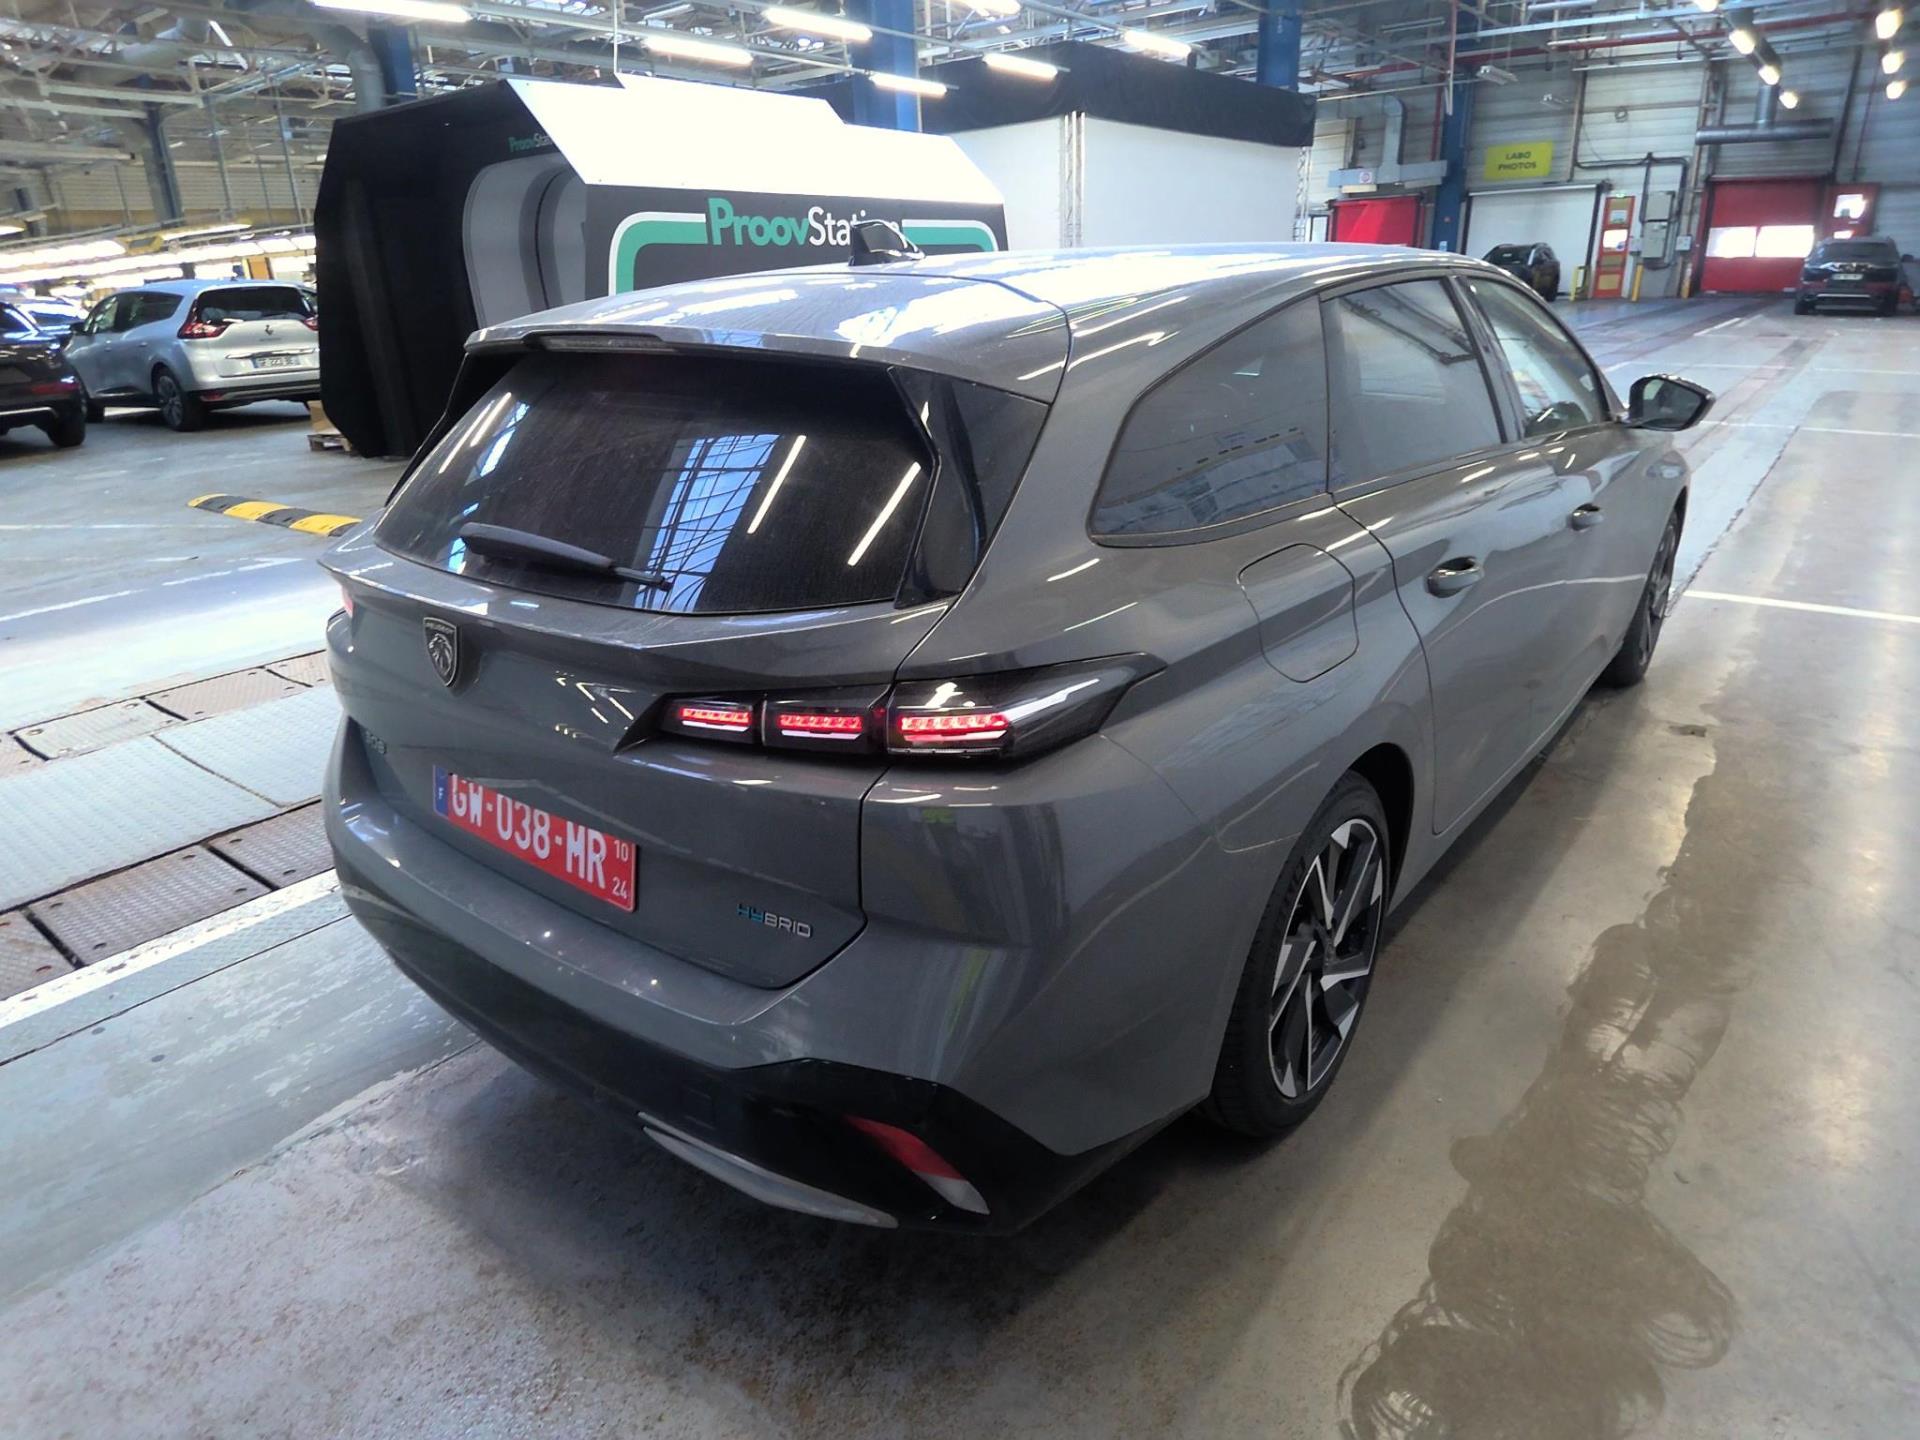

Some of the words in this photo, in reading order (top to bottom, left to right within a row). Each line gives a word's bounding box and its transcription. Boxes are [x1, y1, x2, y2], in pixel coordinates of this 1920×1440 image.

[1498, 161, 1537, 171] PHOTOS
[1505, 151, 1532, 160] LABO
[452, 773, 607, 889] GW-038-MR
[613, 839, 629, 862] 10
[612, 876, 628, 899] 24
[736, 903, 812, 938] HYBRID
